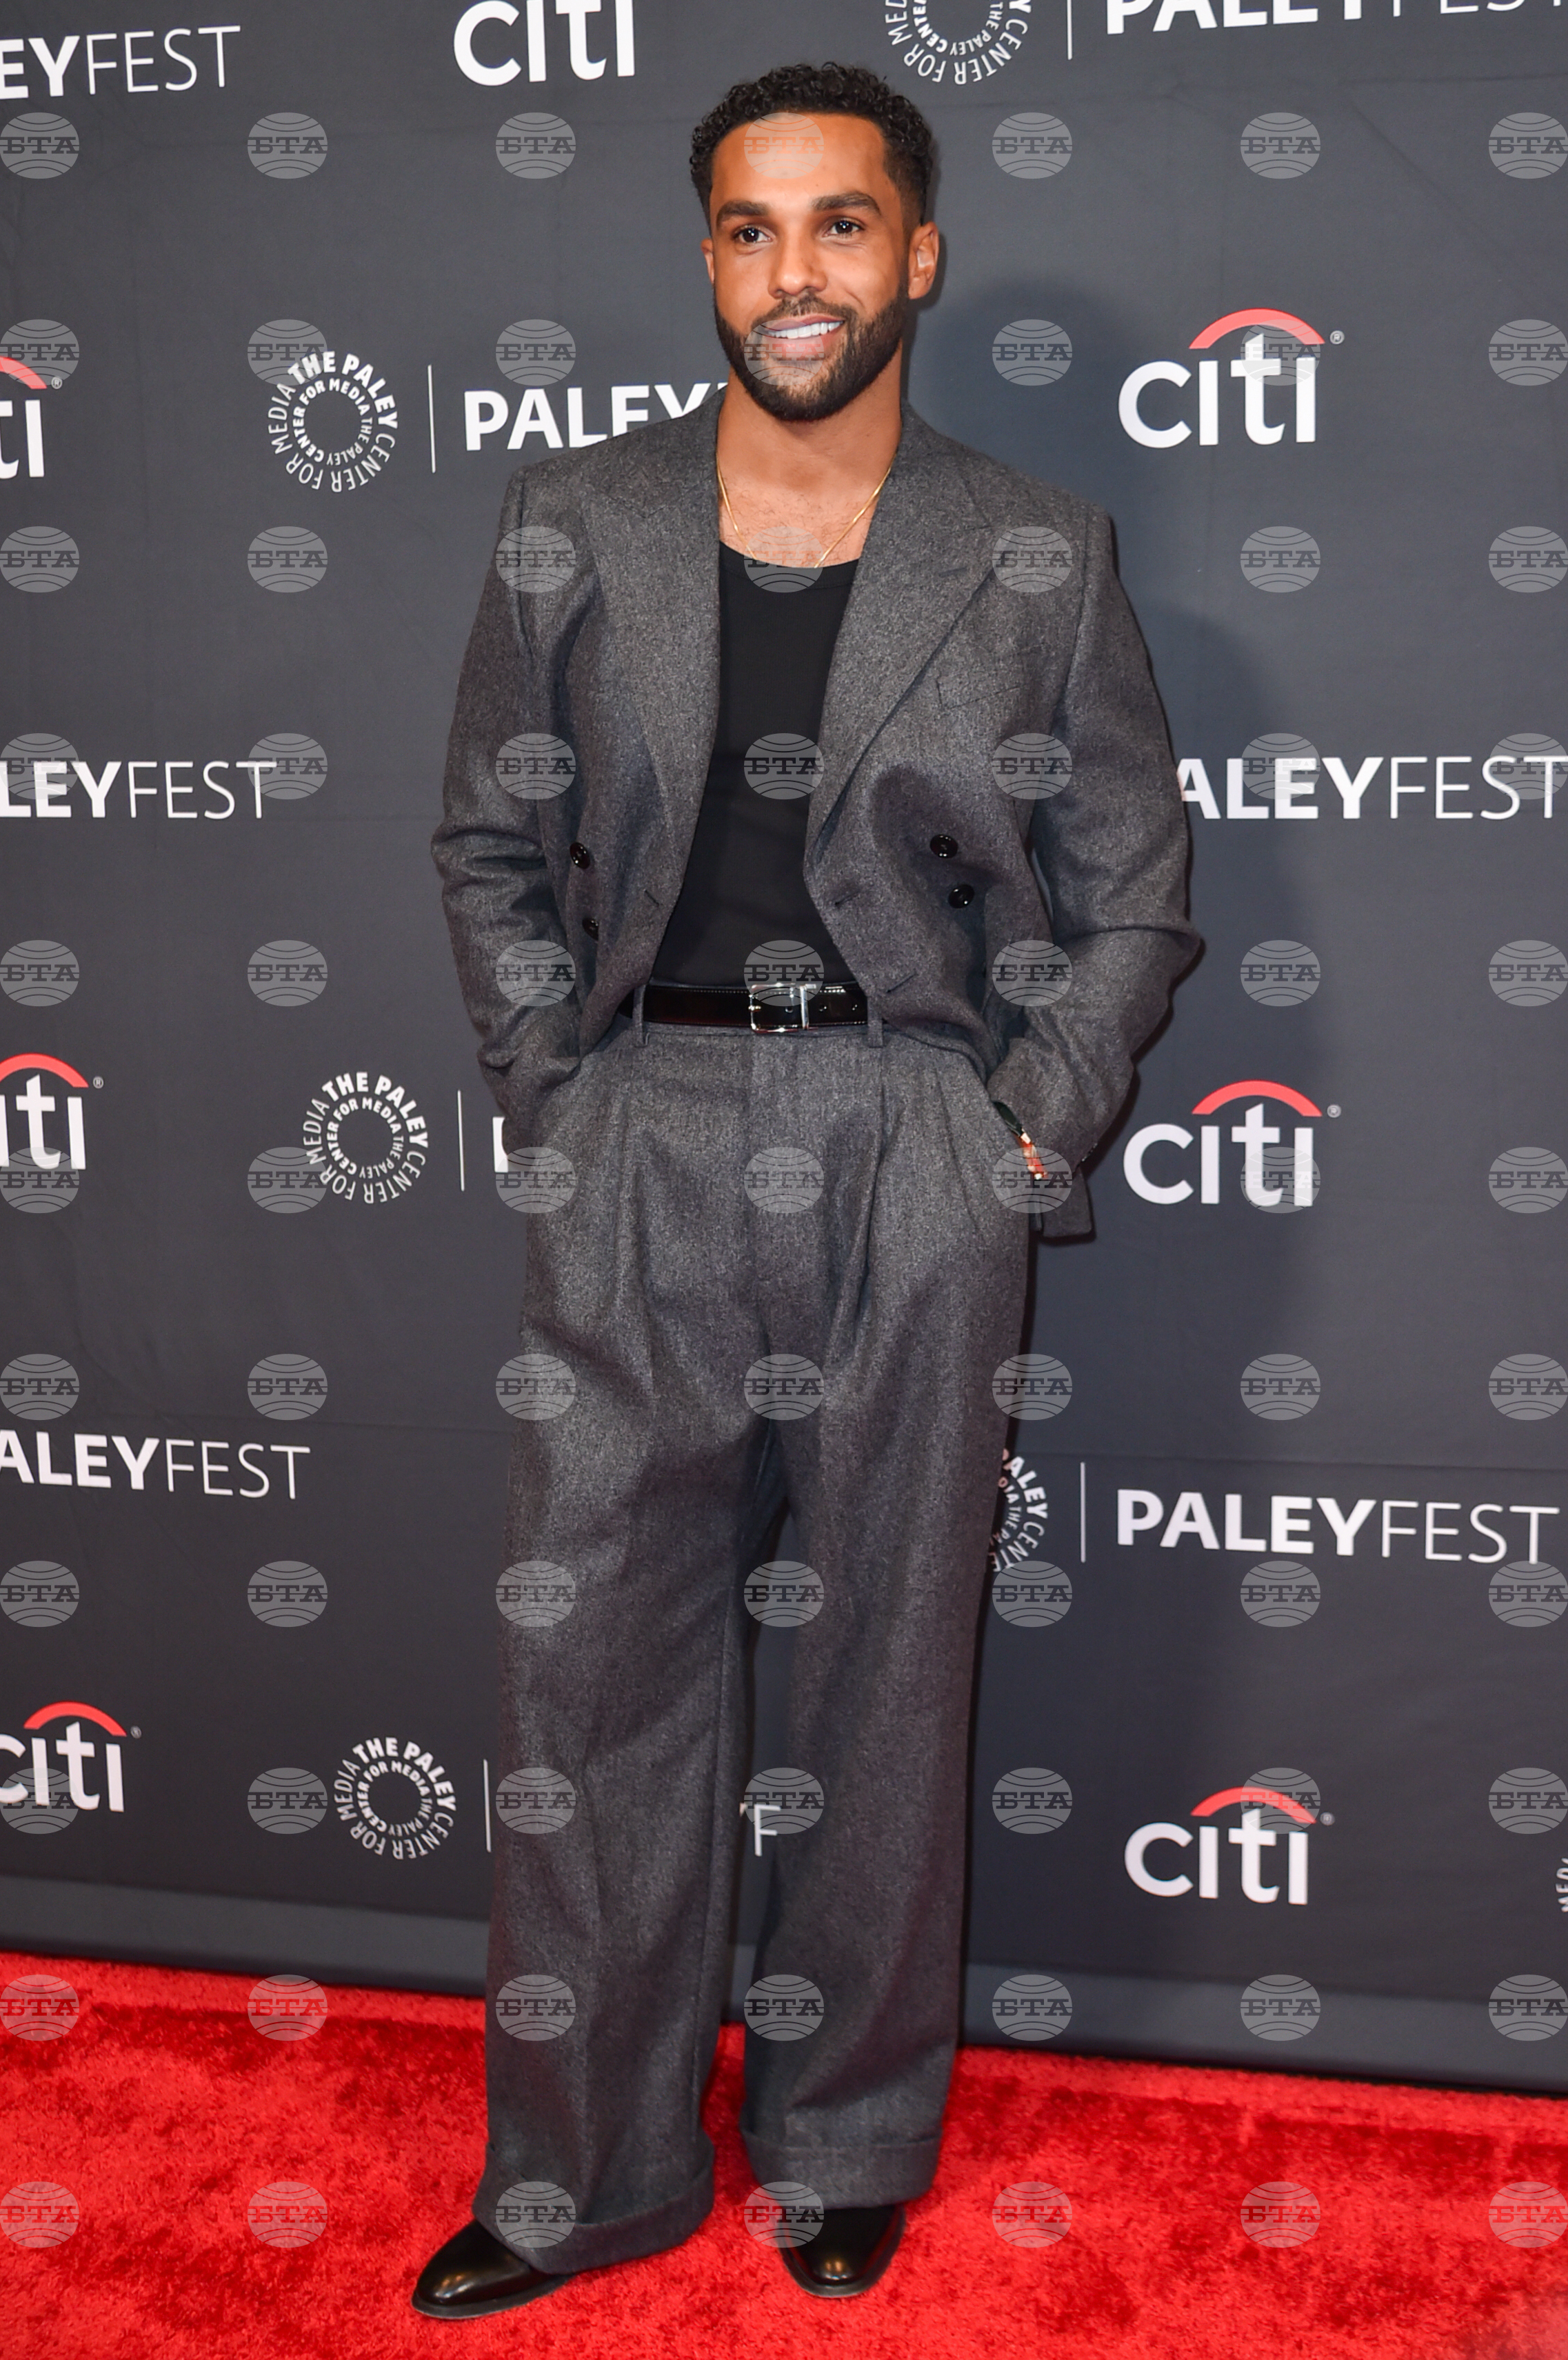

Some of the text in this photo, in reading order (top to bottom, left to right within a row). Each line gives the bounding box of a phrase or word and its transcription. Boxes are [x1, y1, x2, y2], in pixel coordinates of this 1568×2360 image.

[454, 0, 635, 86] citi
[904, 43, 947, 82] FOR
[949, 30, 992, 56] PALEY
[954, 19, 1028, 85] CENTER
[268, 351, 398, 492] THE PALEY CENTER FOR MEDIA
[292, 378, 373, 466] THE PALEY CENTER FOR MEDIA
[464, 383, 728, 450] PALEY
[1118, 333, 1316, 448] citi
[303, 1072, 429, 1204] THE PALEY CENTER FOR MEDIA
[327, 1097, 404, 1179] THE PALEY CENTER FOR MEDIA
[1123, 1103, 1314, 1206] citi
[1003, 1448, 1048, 1519] ALEY
[1117, 1489, 1560, 1565] PALEYFEST
[334, 1737, 456, 1860] THE PALEY CENTER FOR MEDIA
[356, 1781, 387, 1832] CENTER
[363, 1761, 389, 1782] FOR
[391, 1760, 431, 1797] MEDIA
[1124, 1808, 1309, 1906] citi
